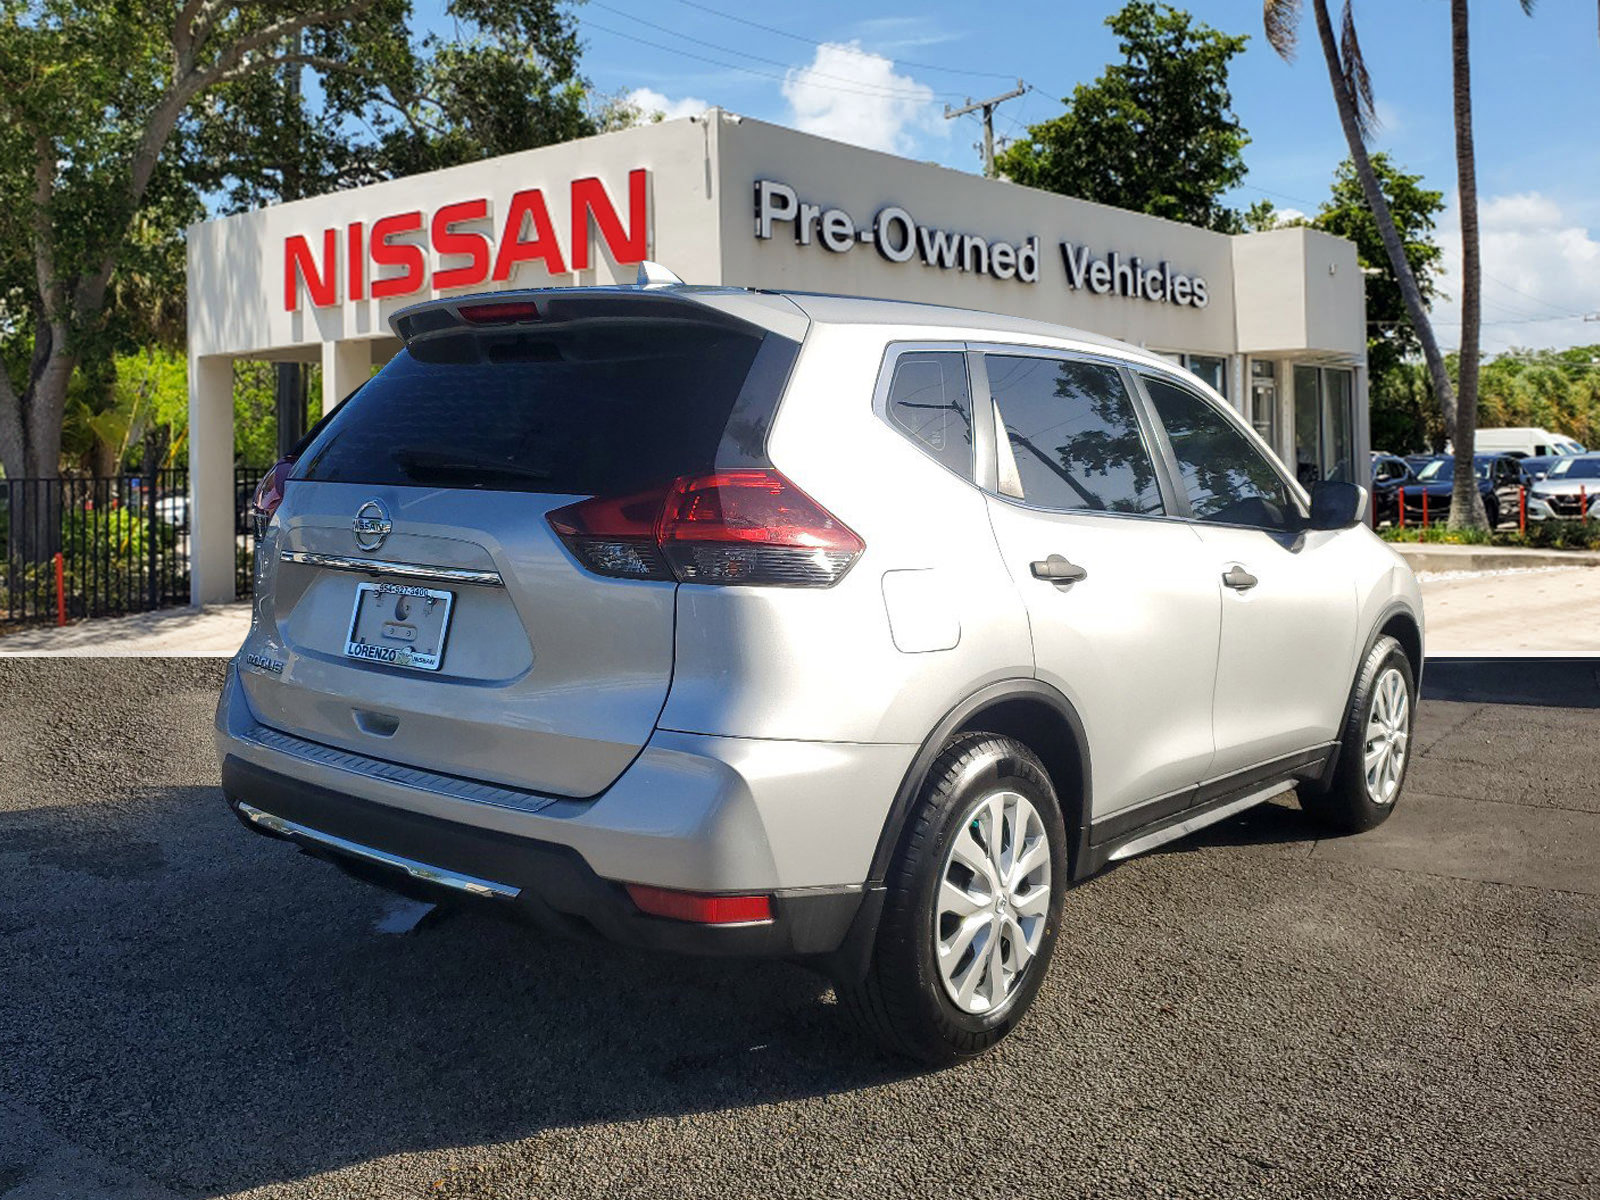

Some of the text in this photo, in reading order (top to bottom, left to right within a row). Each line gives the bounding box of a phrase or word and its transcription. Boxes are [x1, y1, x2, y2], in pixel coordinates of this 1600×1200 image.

[284, 168, 648, 312] NISSAN
[754, 179, 1209, 309] Pre-Owned Vehicles
[347, 643, 397, 661] LORENZO
